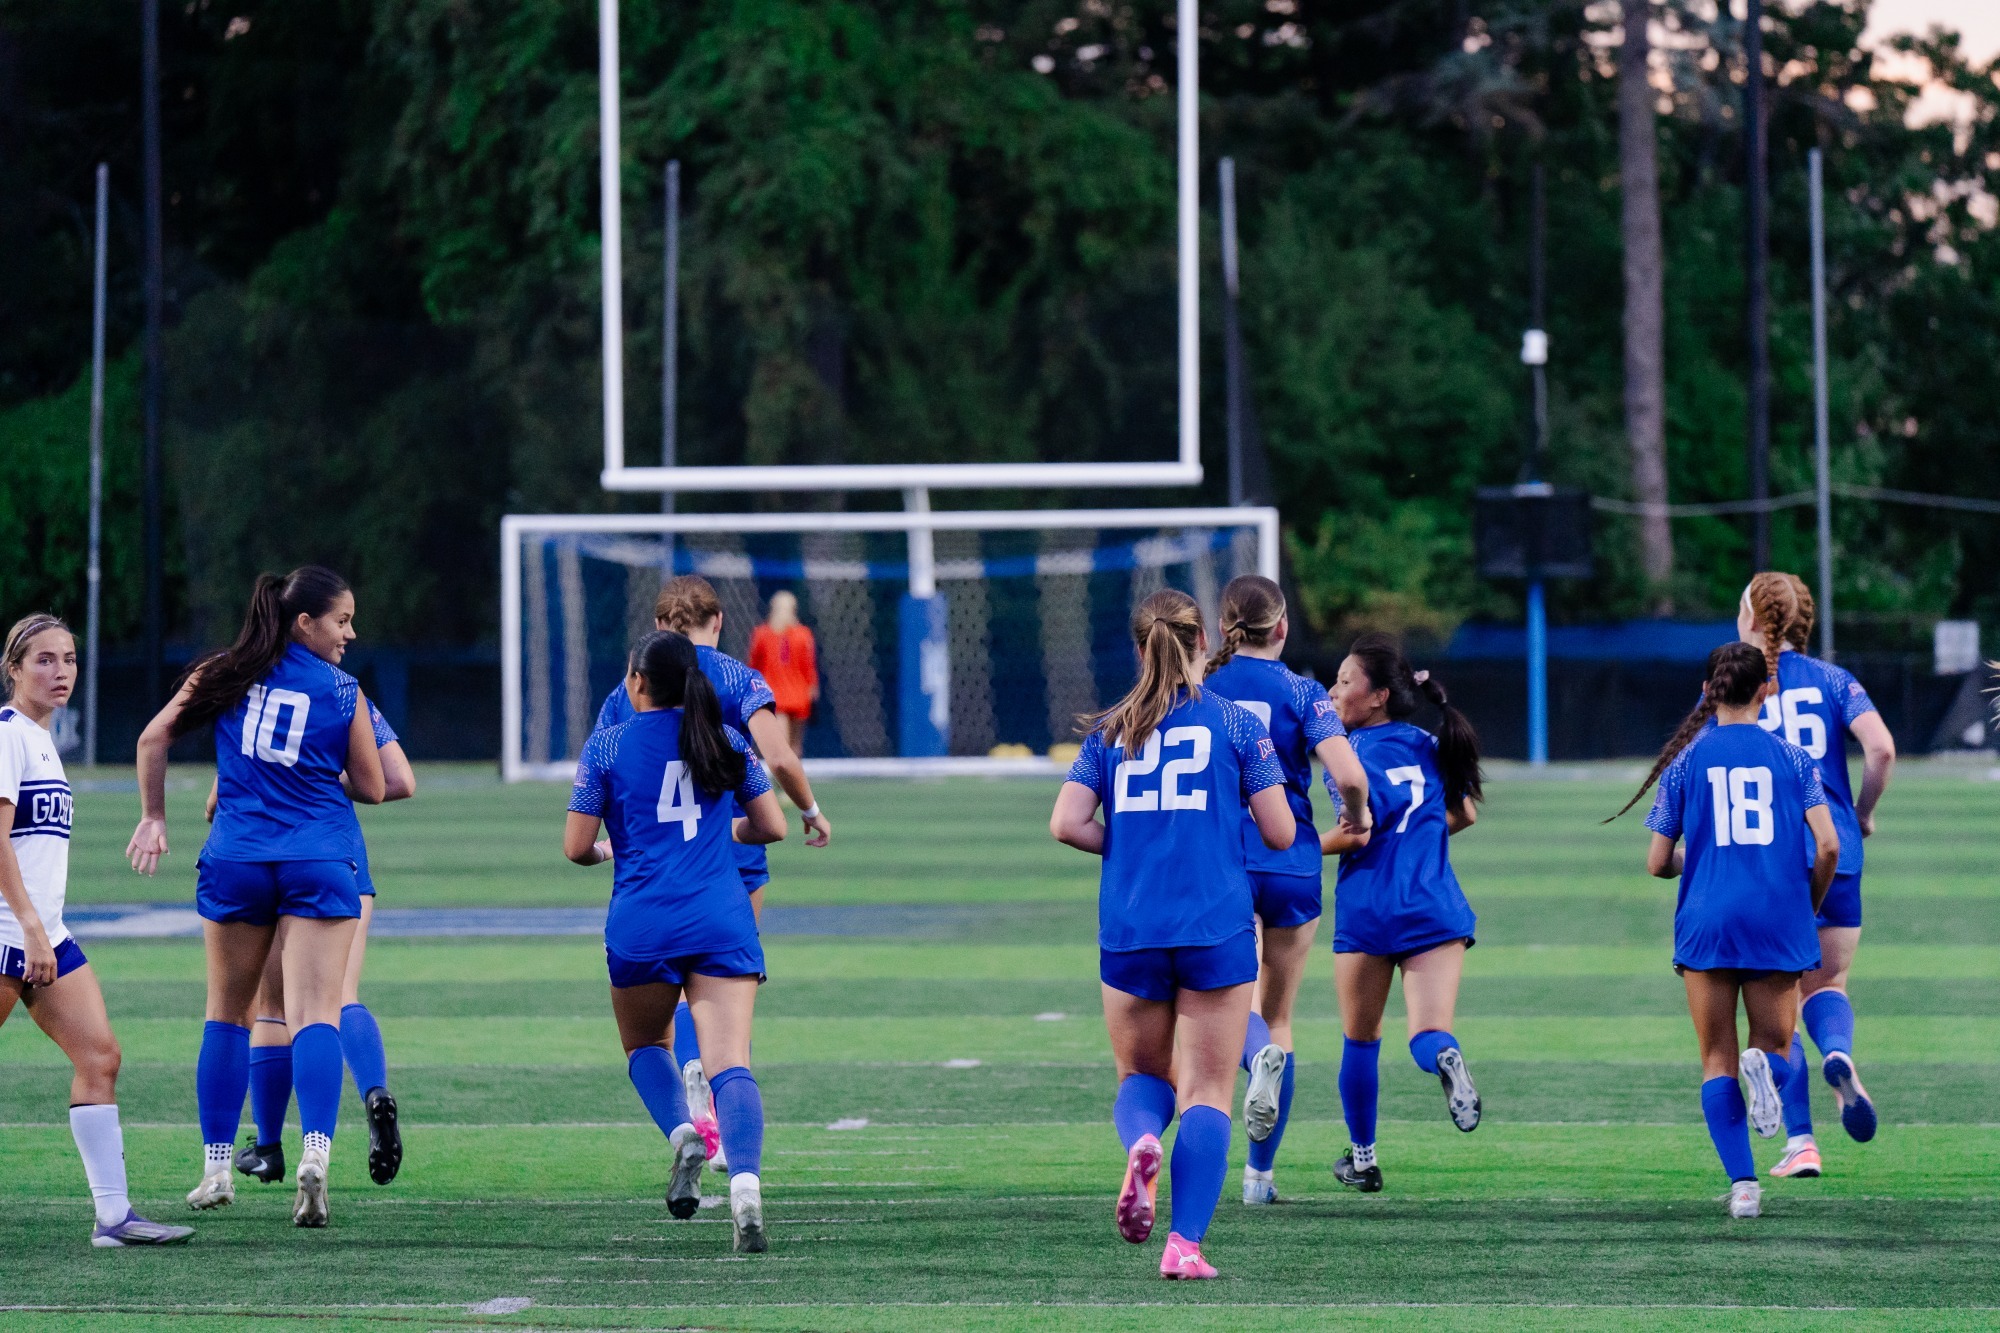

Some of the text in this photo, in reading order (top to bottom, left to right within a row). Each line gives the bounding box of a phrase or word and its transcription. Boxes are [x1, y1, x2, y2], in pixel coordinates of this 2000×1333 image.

[242, 683, 311, 768] 10
[656, 760, 702, 842] 4
[1114, 725, 1212, 814] 22
[1385, 765, 1426, 833] 7
[1706, 766, 1774, 847] 18
